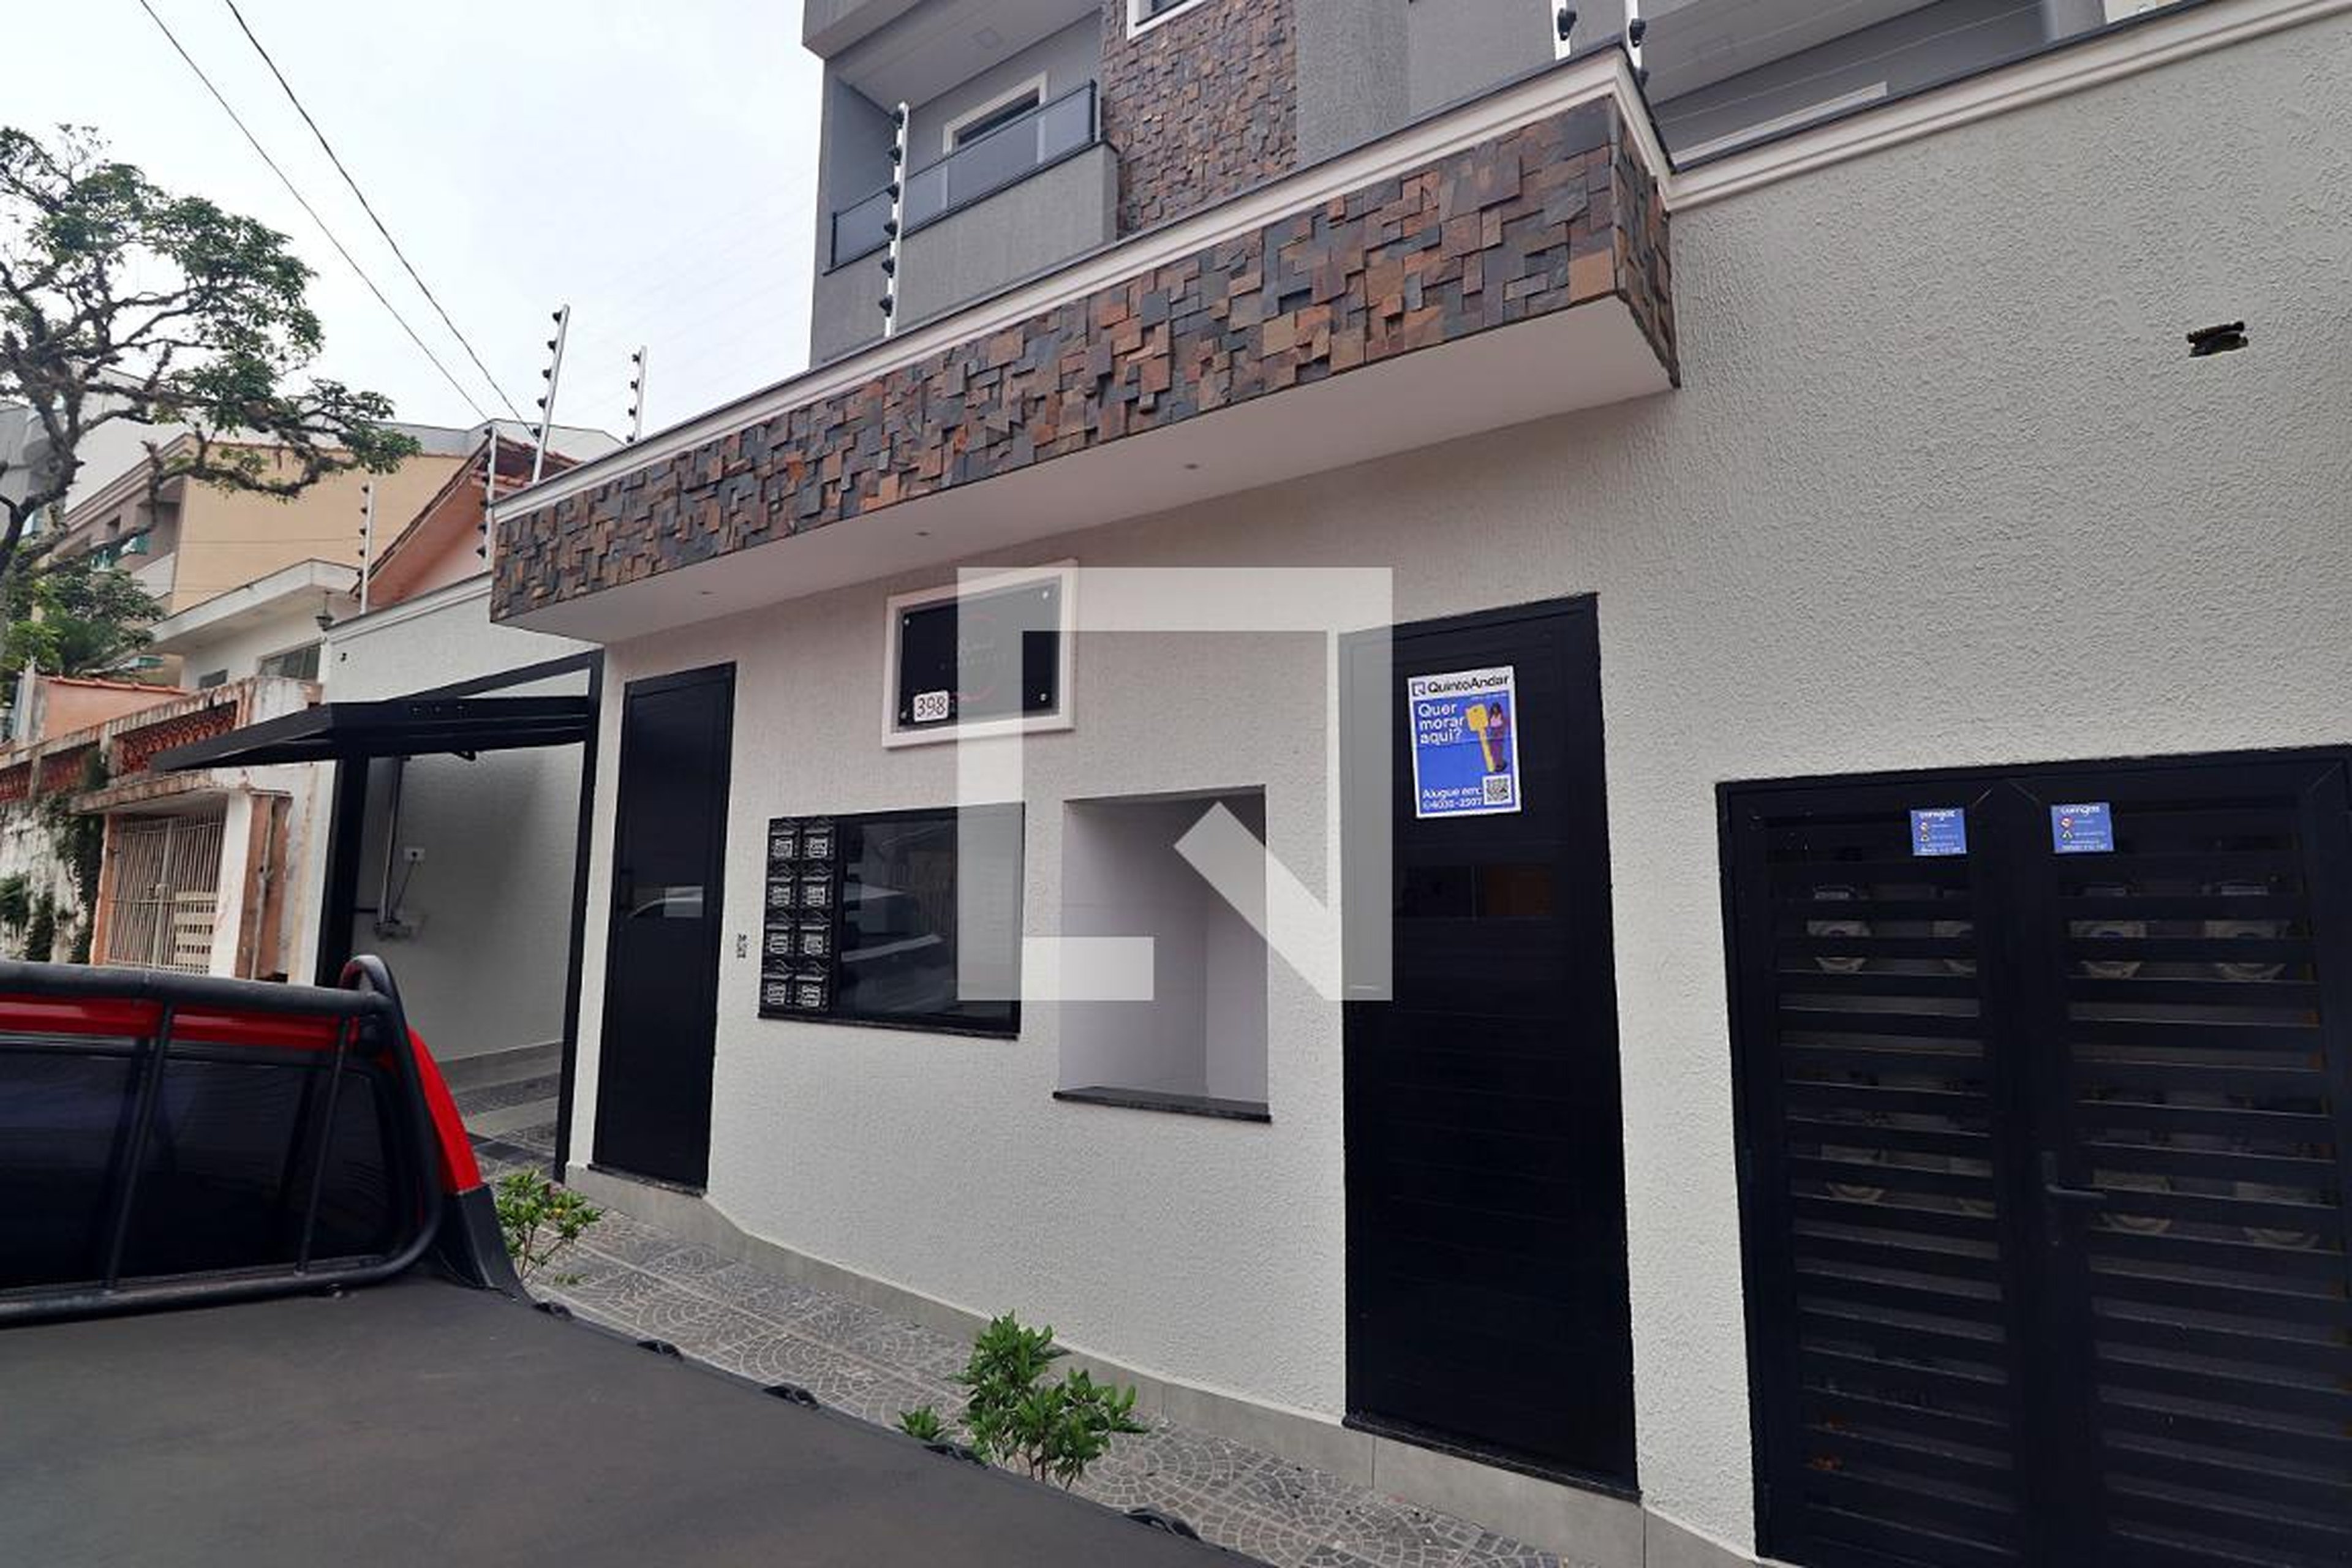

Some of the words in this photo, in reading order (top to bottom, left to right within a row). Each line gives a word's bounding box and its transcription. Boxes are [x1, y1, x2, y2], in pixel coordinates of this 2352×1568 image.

[1428, 676, 1509, 693] QuintoAndar
[917, 695, 946, 717] 398
[1419, 704, 1457, 717] Quer
[1420, 716, 1464, 731] morar
[1420, 729, 1462, 745] aqui?
[1422, 788, 1460, 801] Alugue
